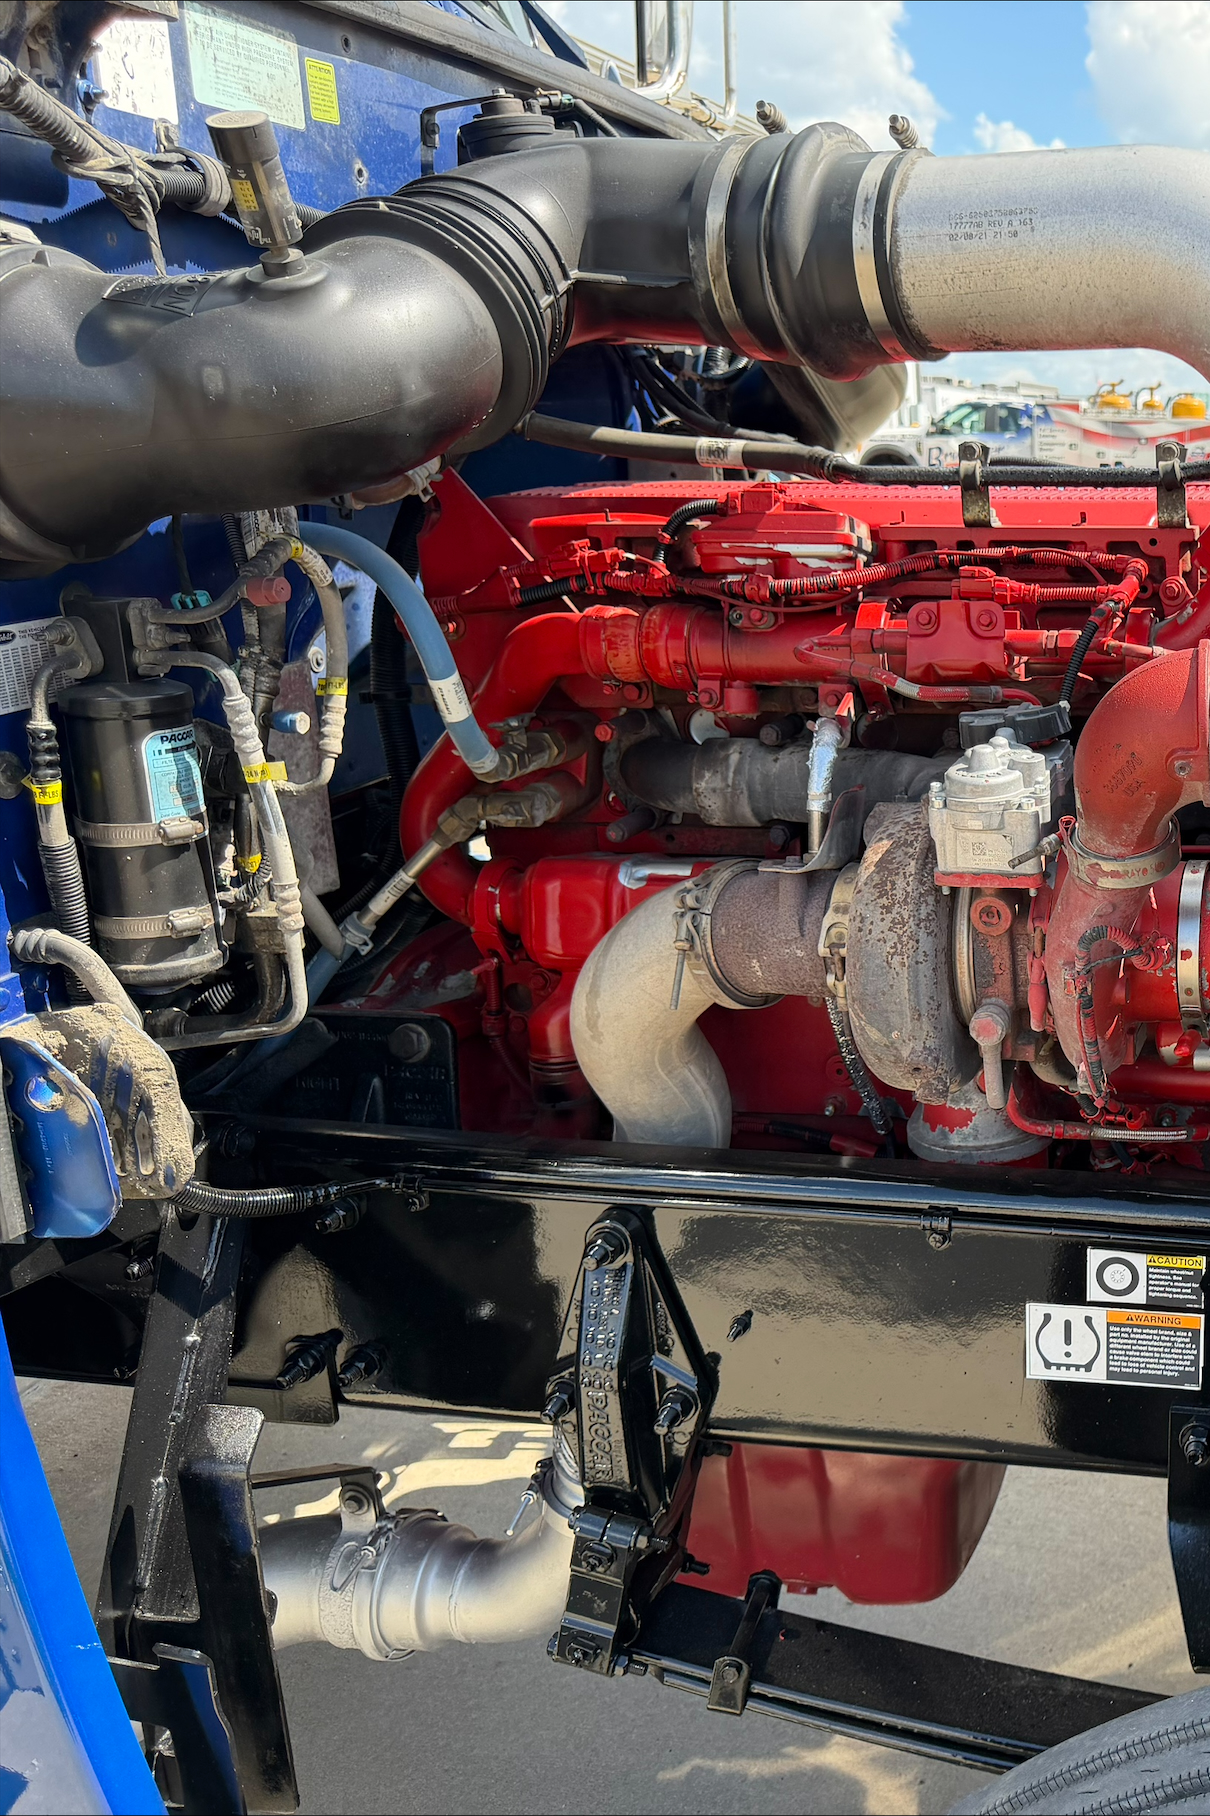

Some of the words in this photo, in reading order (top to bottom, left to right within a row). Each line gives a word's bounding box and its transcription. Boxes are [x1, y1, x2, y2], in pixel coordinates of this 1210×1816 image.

[1123, 778, 1146, 798] USA
[1157, 1257, 1201, 1266] CAUTION
[1134, 1315, 1181, 1325] WARNING
[586, 1390, 614, 1482] PACCAR
